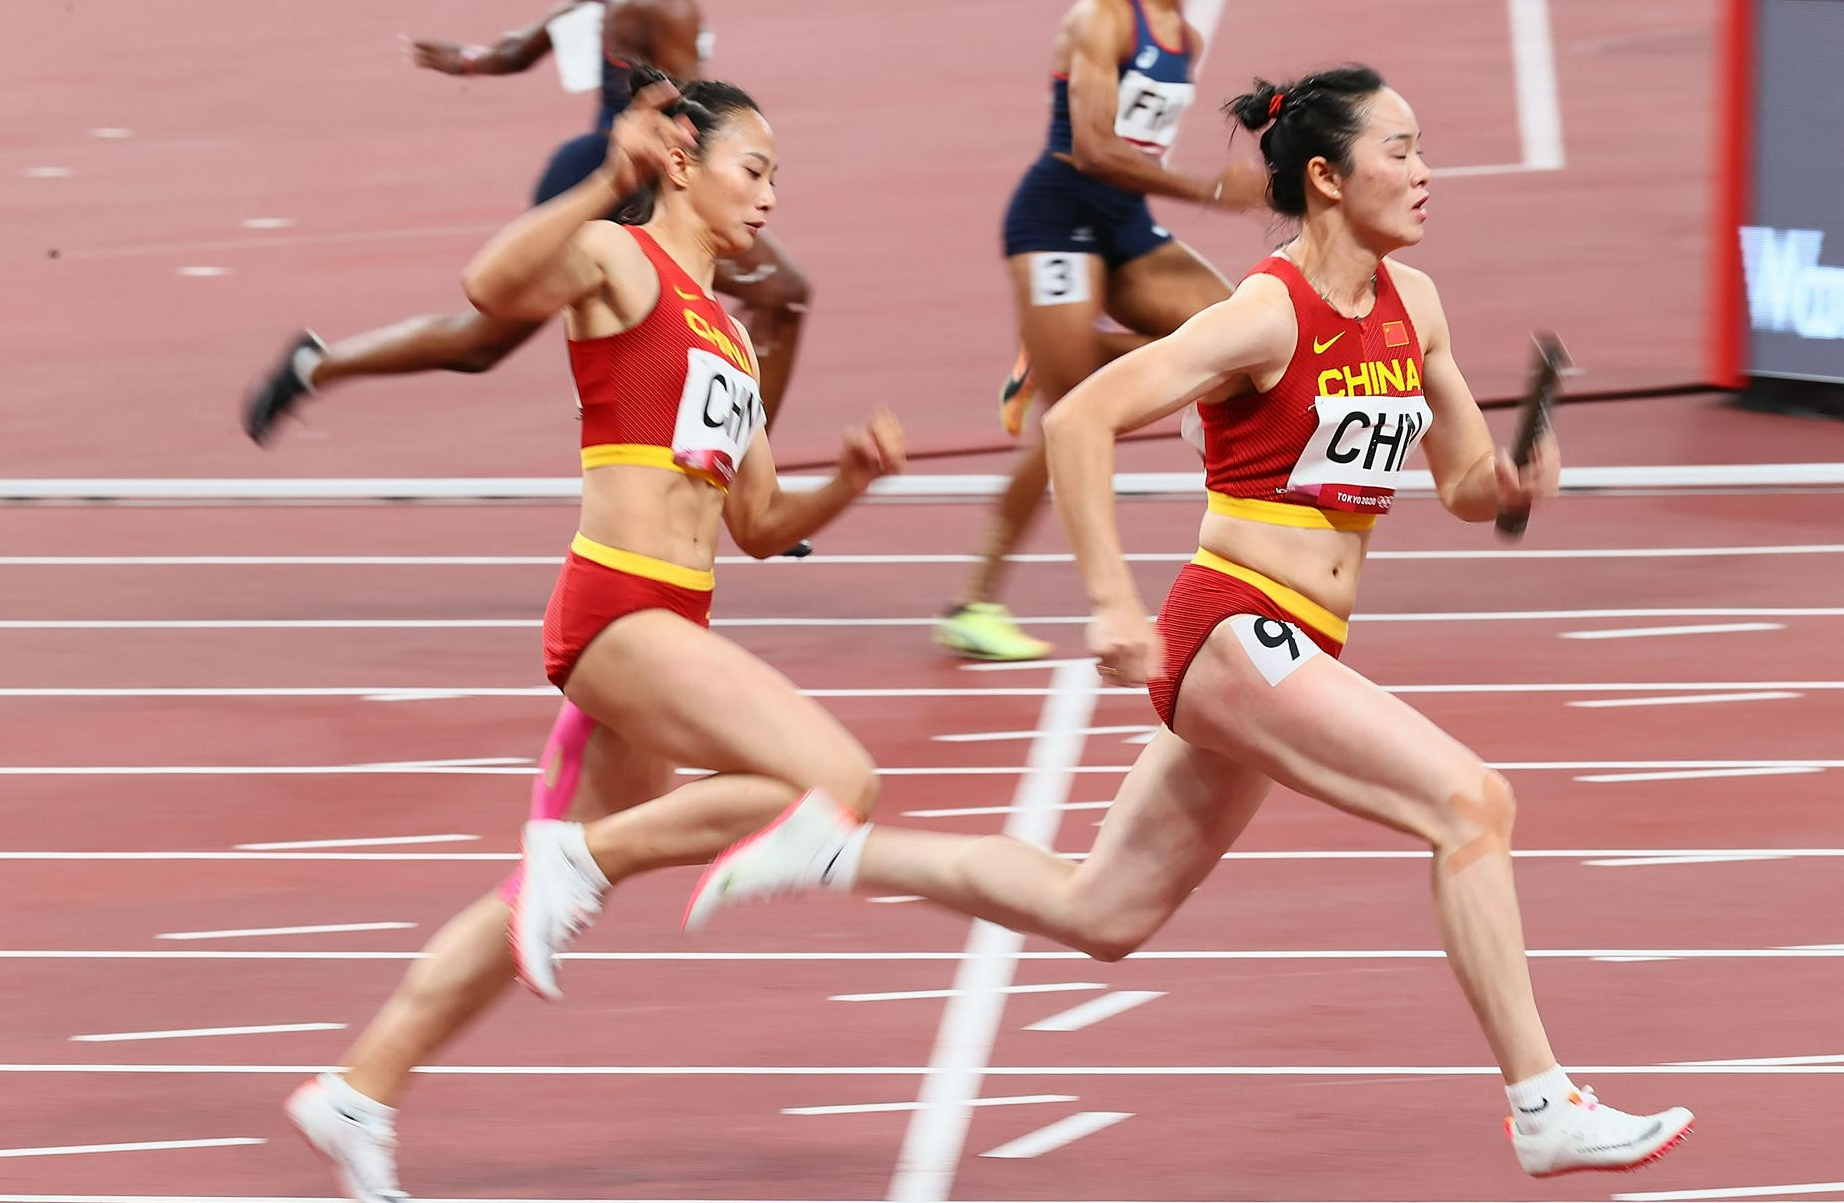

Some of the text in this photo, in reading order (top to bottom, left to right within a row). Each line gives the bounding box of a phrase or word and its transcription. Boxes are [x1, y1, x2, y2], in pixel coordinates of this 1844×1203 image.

[1042, 258, 1077, 299] 3
[1317, 357, 1422, 398] CHINA
[1325, 410, 1423, 473] CHN
[1253, 616, 1301, 661] 9
